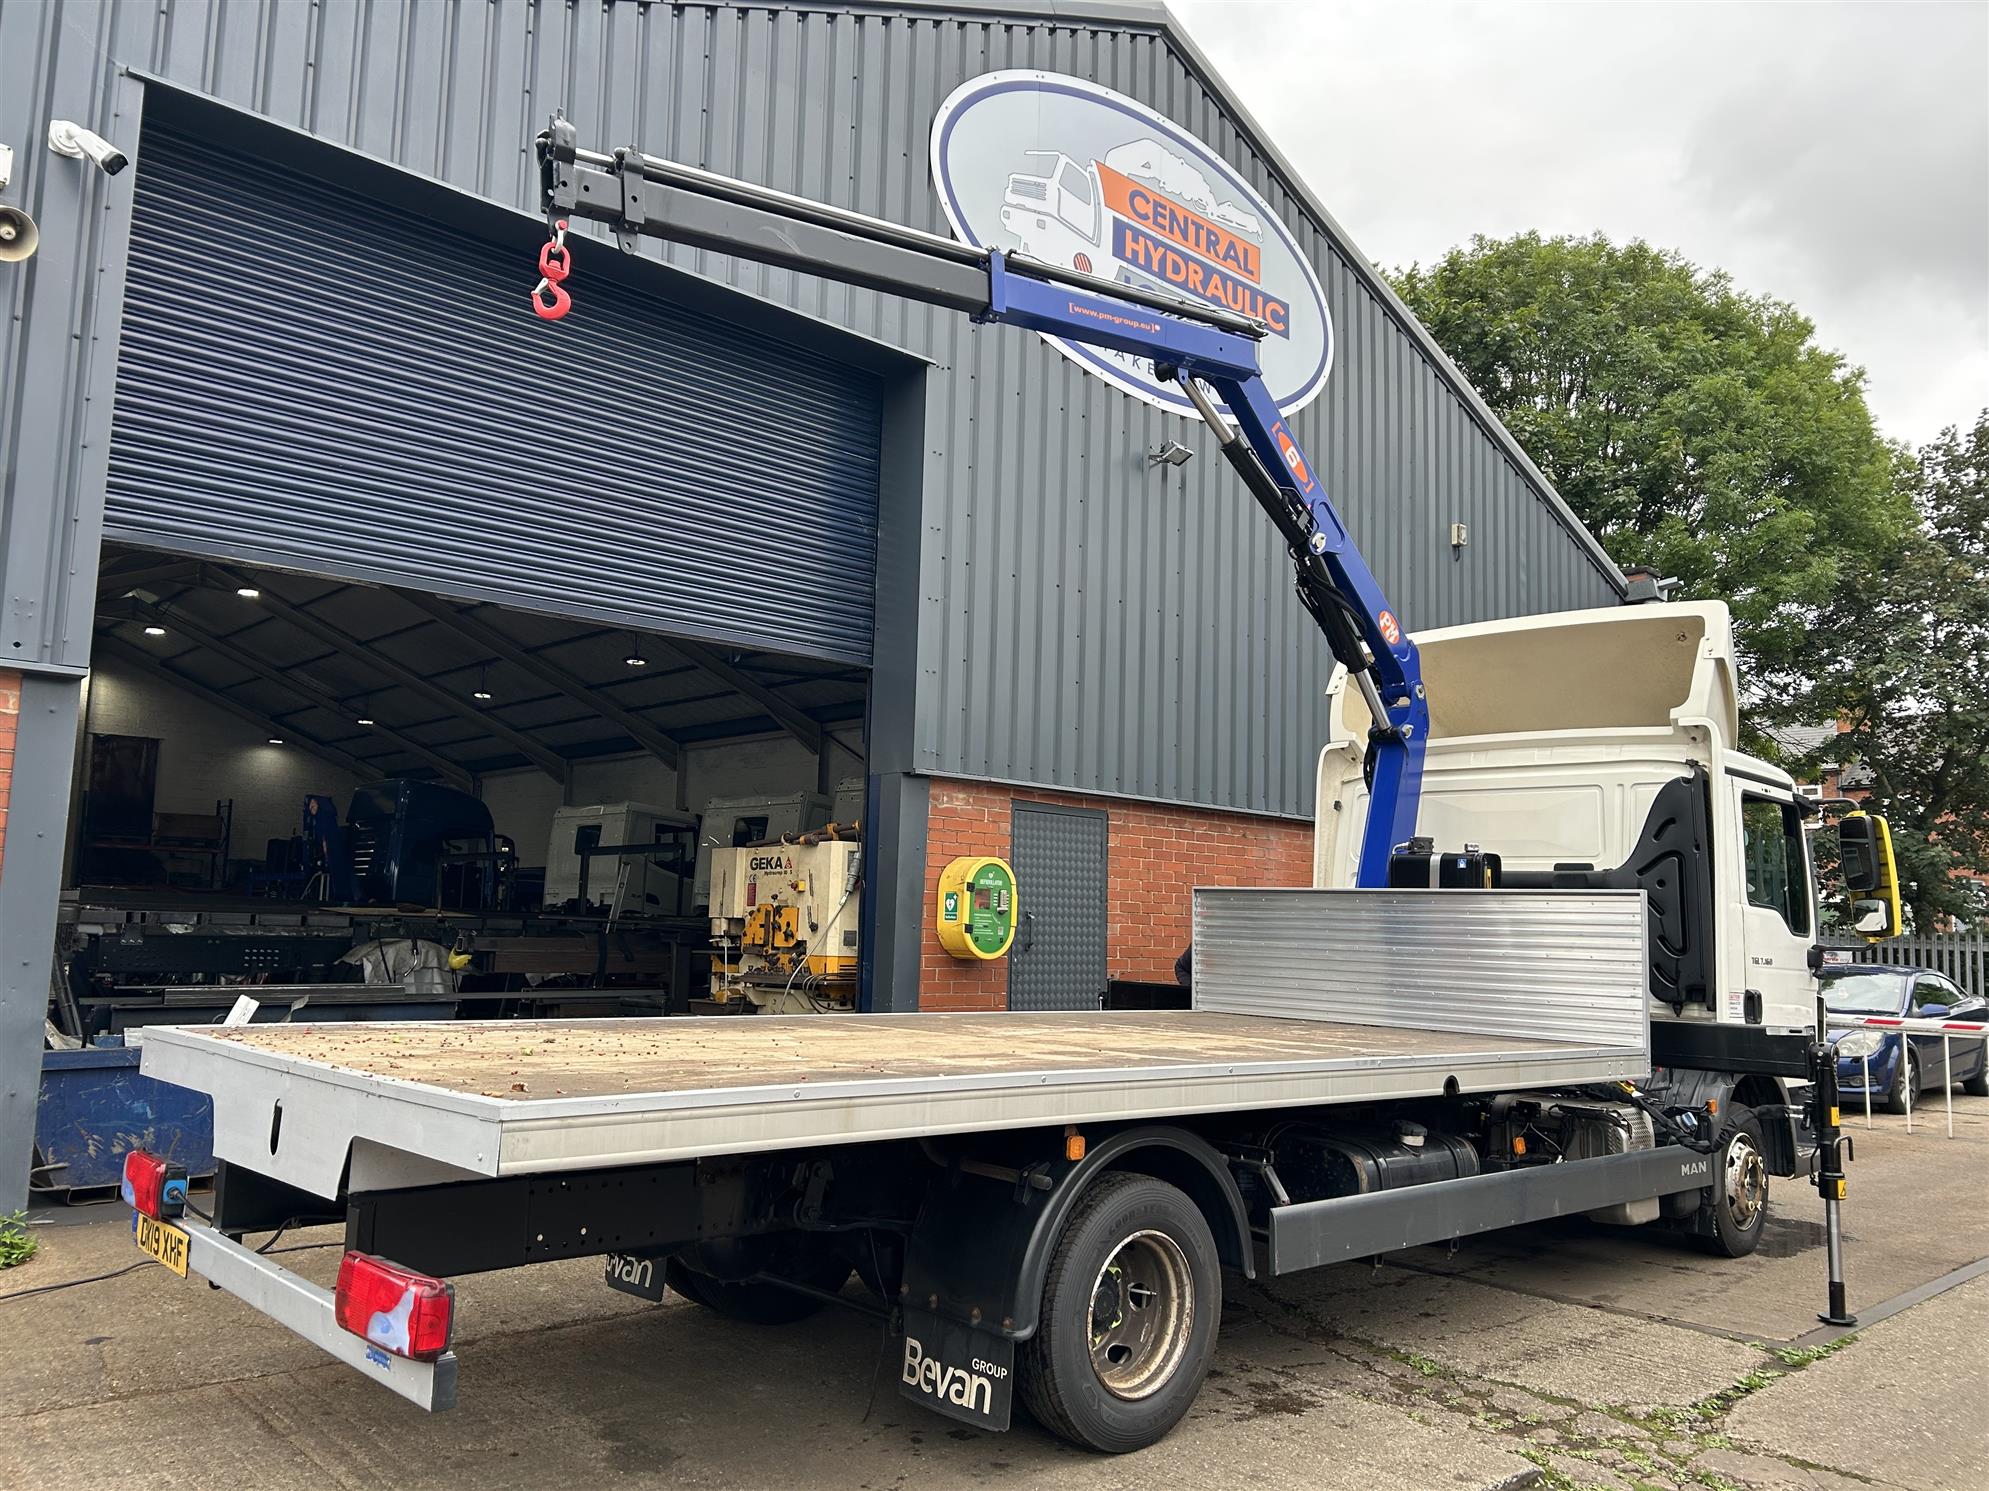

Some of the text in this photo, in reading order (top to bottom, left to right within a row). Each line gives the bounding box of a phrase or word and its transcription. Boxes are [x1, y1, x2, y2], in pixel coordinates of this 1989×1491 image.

[1128, 189, 1255, 277] CENTRAL
[1125, 228, 1285, 332] HYDRAULIC
[1379, 611, 1400, 644] PM
[750, 856, 783, 870] GEKA
[1681, 1161, 1707, 1176] MAN
[162, 1230, 183, 1267] XHF
[902, 1336, 992, 1415] Bevan
[971, 1358, 1008, 1380] GROUP
